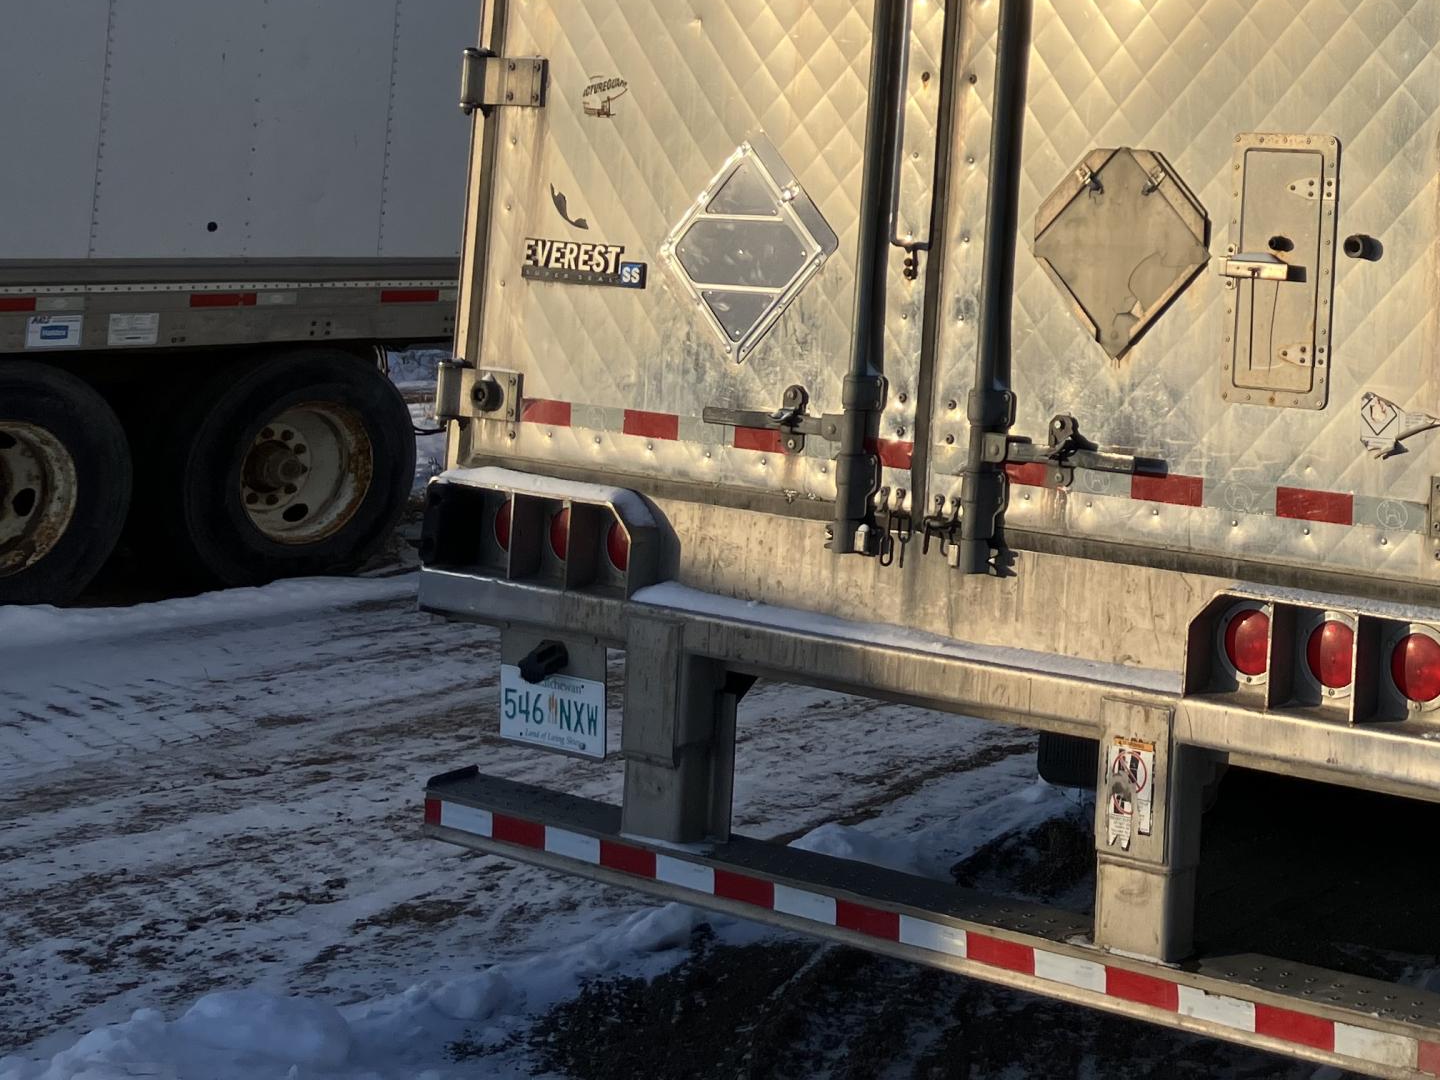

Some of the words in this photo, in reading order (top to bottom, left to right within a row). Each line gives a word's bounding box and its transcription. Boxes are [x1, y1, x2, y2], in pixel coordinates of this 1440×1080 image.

[525, 237, 625, 275] EVEREST
[621, 265, 641, 284] SS
[504, 687, 545, 725] 546
[559, 698, 599, 737] NXW
